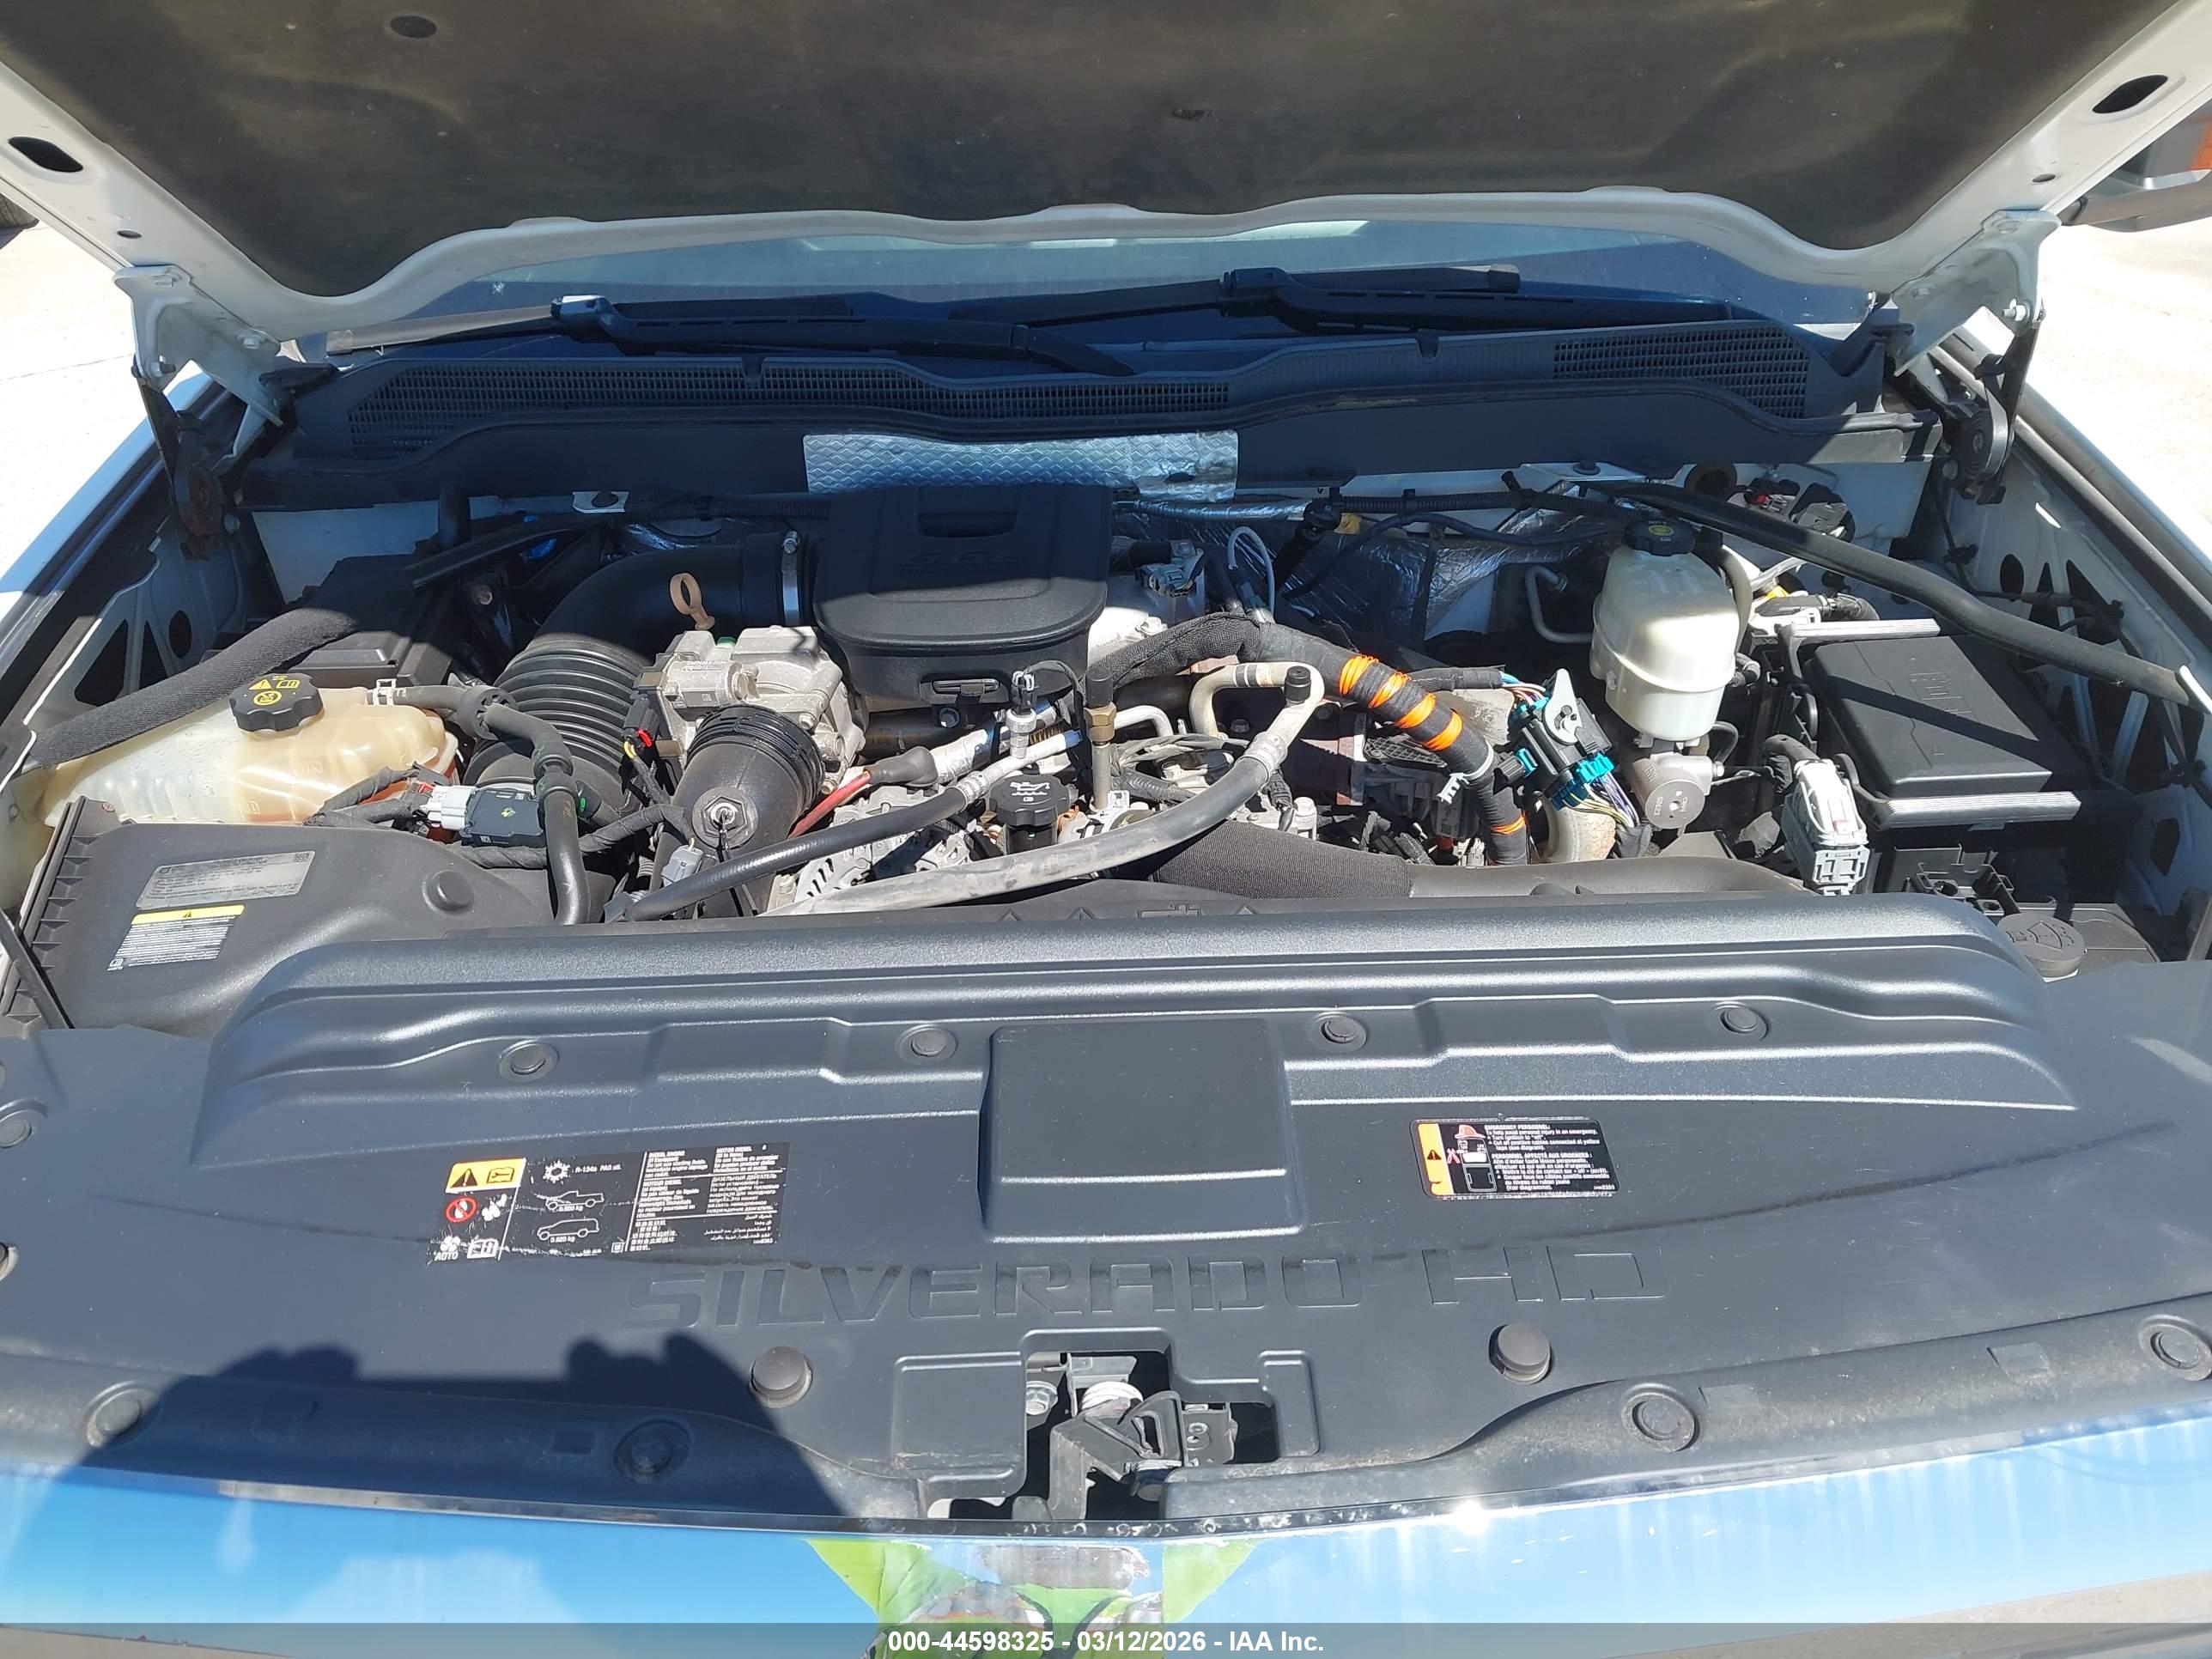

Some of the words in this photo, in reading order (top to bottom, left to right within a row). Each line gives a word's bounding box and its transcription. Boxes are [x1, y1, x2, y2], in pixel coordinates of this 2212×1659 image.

[434, 1251, 459, 1261] AUTO
[622, 1254, 1361, 1328] SILVERADO
[1421, 1245, 1667, 1304] HD
